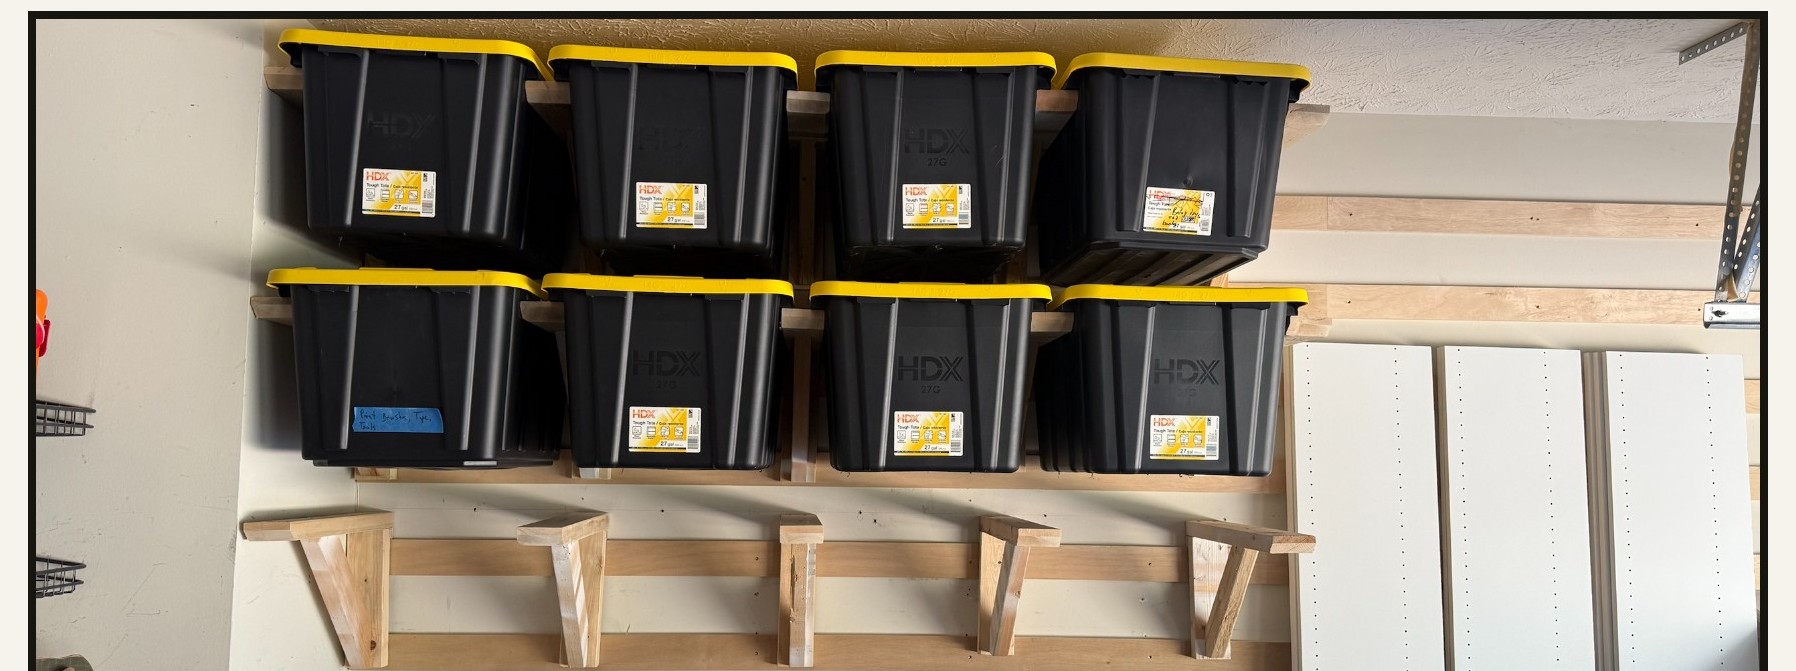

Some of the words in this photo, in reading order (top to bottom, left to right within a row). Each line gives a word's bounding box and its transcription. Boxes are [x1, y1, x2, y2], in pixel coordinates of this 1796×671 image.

[904, 128, 970, 154] HDX
[927, 157, 948, 167] 27G
[366, 171, 389, 181] HDX
[639, 185, 662, 195] HDX
[905, 186, 928, 196] HDX
[633, 350, 701, 376] HDX
[898, 355, 964, 382] HDX
[1154, 359, 1221, 385] HDX
[921, 385, 941, 394] 27G
[632, 409, 656, 419] HDX
[897, 414, 920, 423] HDX
[1153, 417, 1175, 427] HDX
